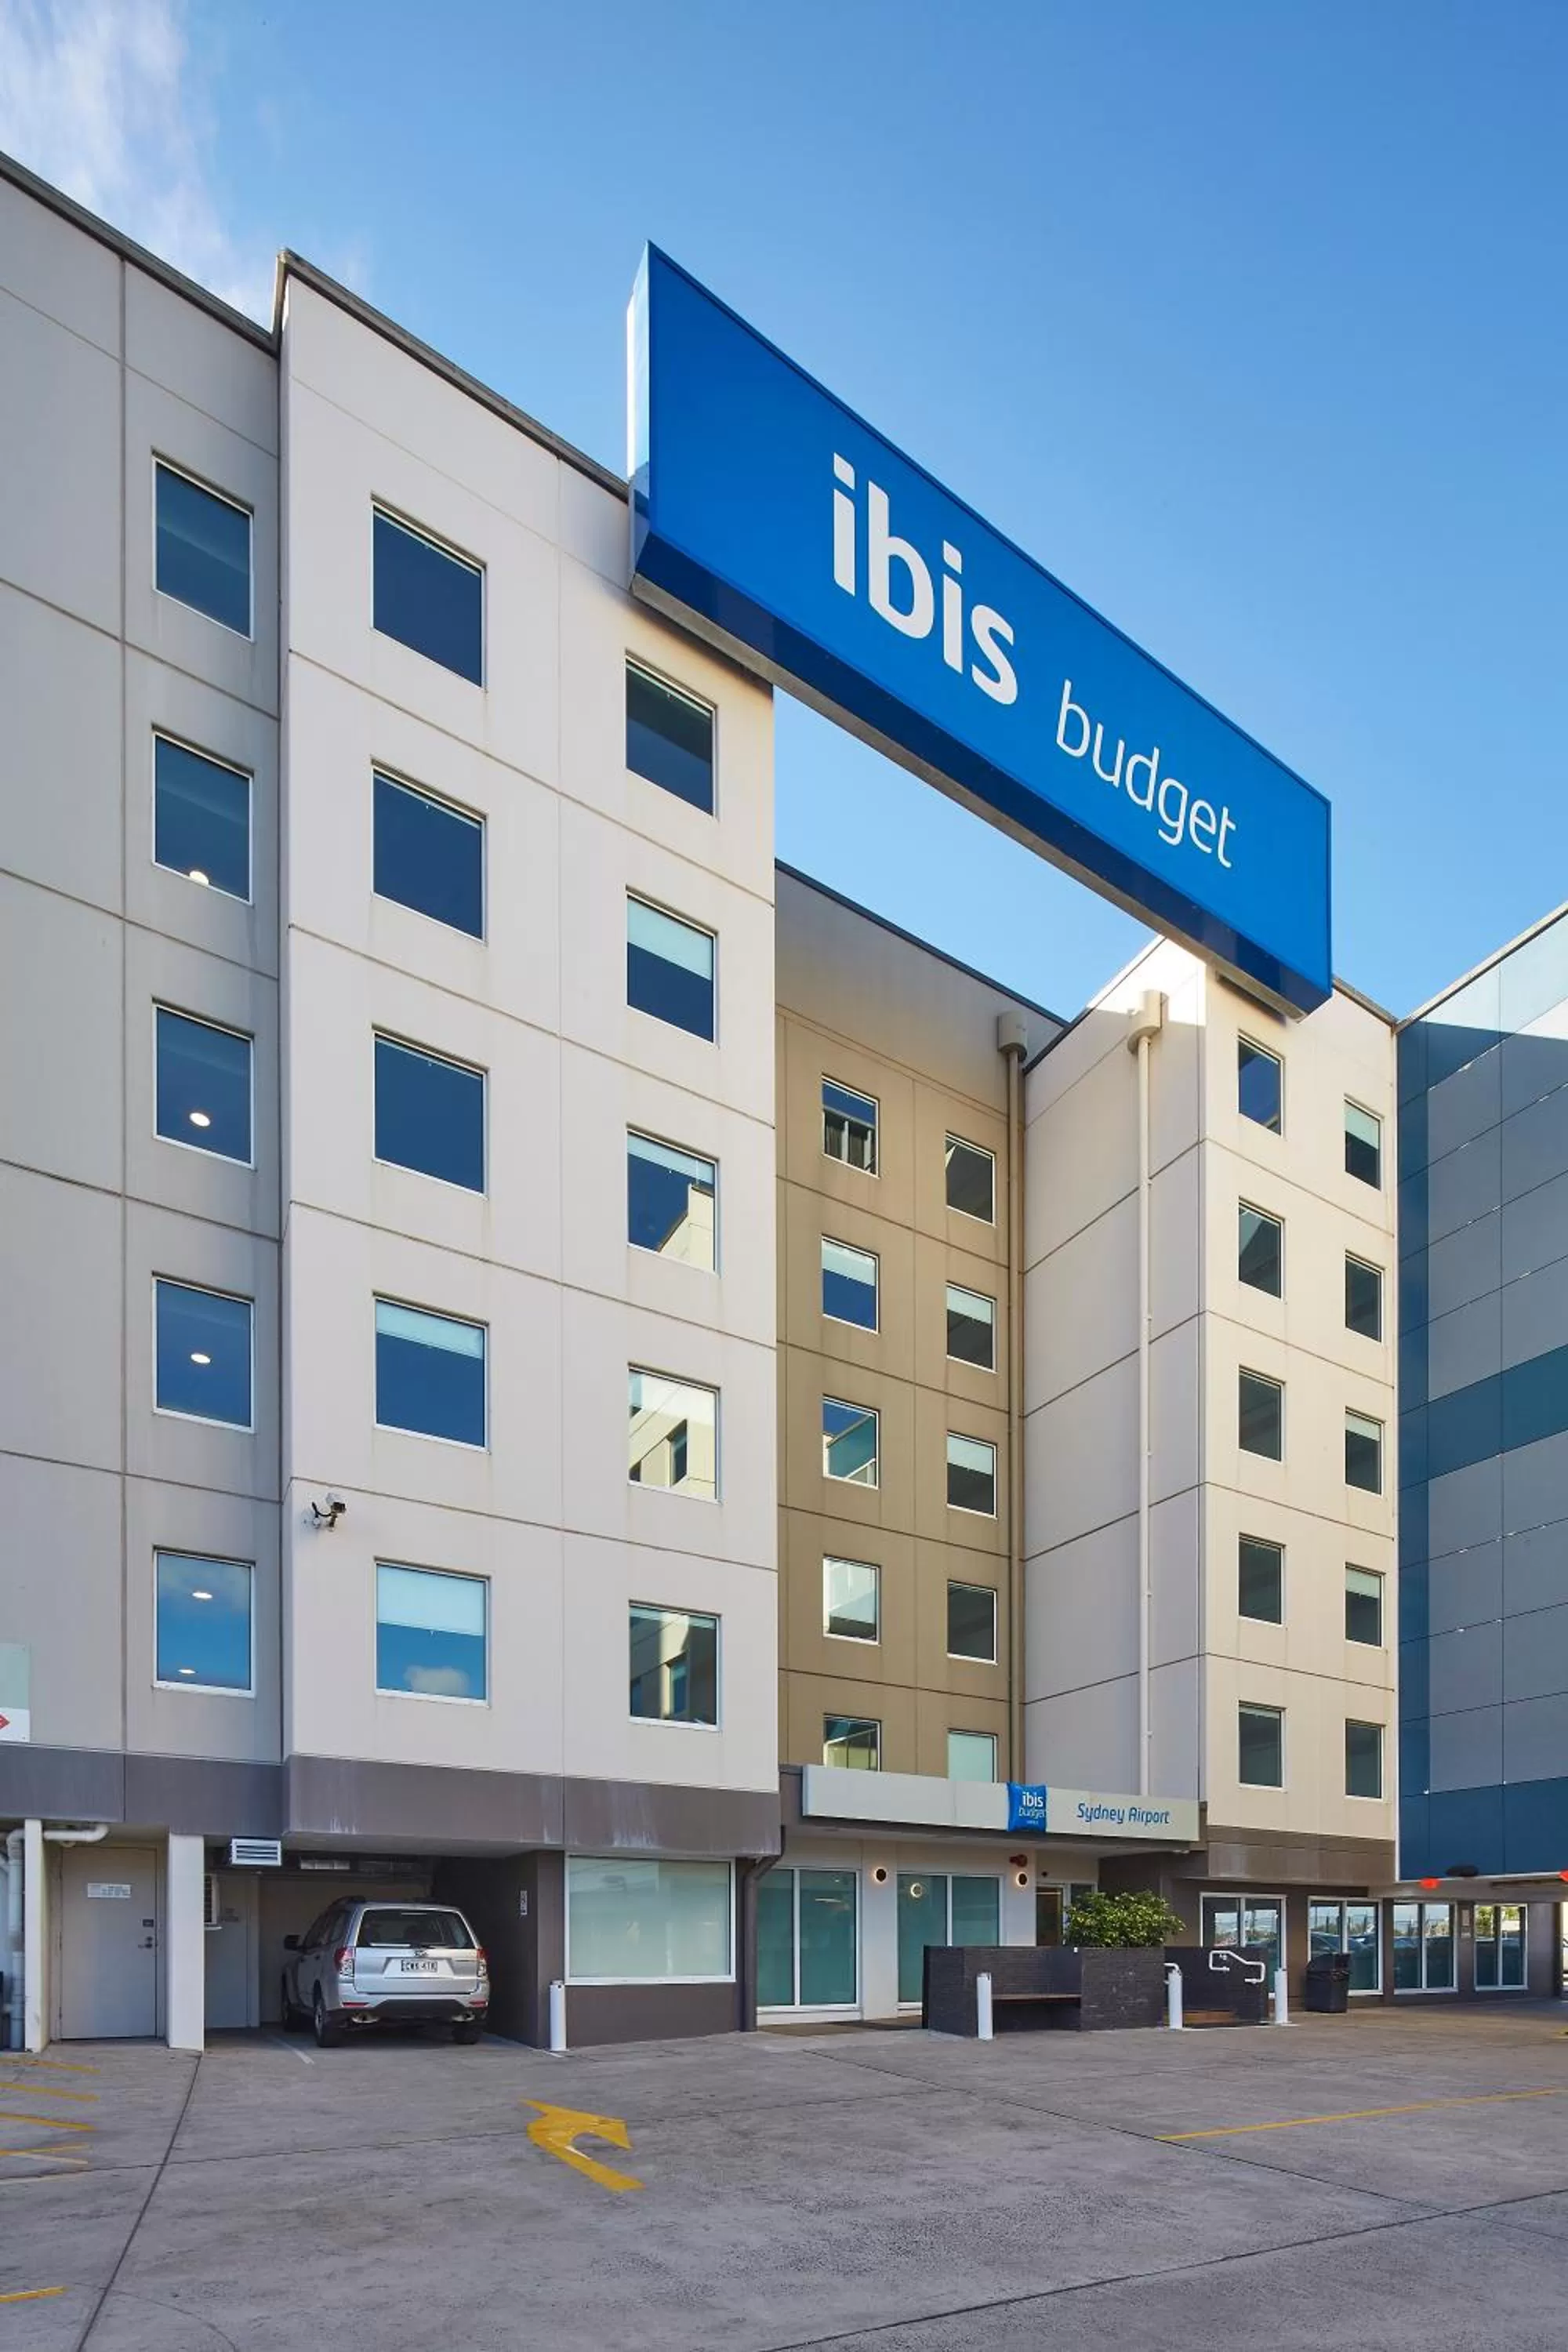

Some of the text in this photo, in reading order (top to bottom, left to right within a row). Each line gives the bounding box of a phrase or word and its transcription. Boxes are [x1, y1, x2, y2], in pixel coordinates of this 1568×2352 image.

[833, 452, 1237, 869] ibis budget
[1022, 1791, 1044, 1807] ibis
[1077, 1802, 1171, 1825] Sydney Airport
